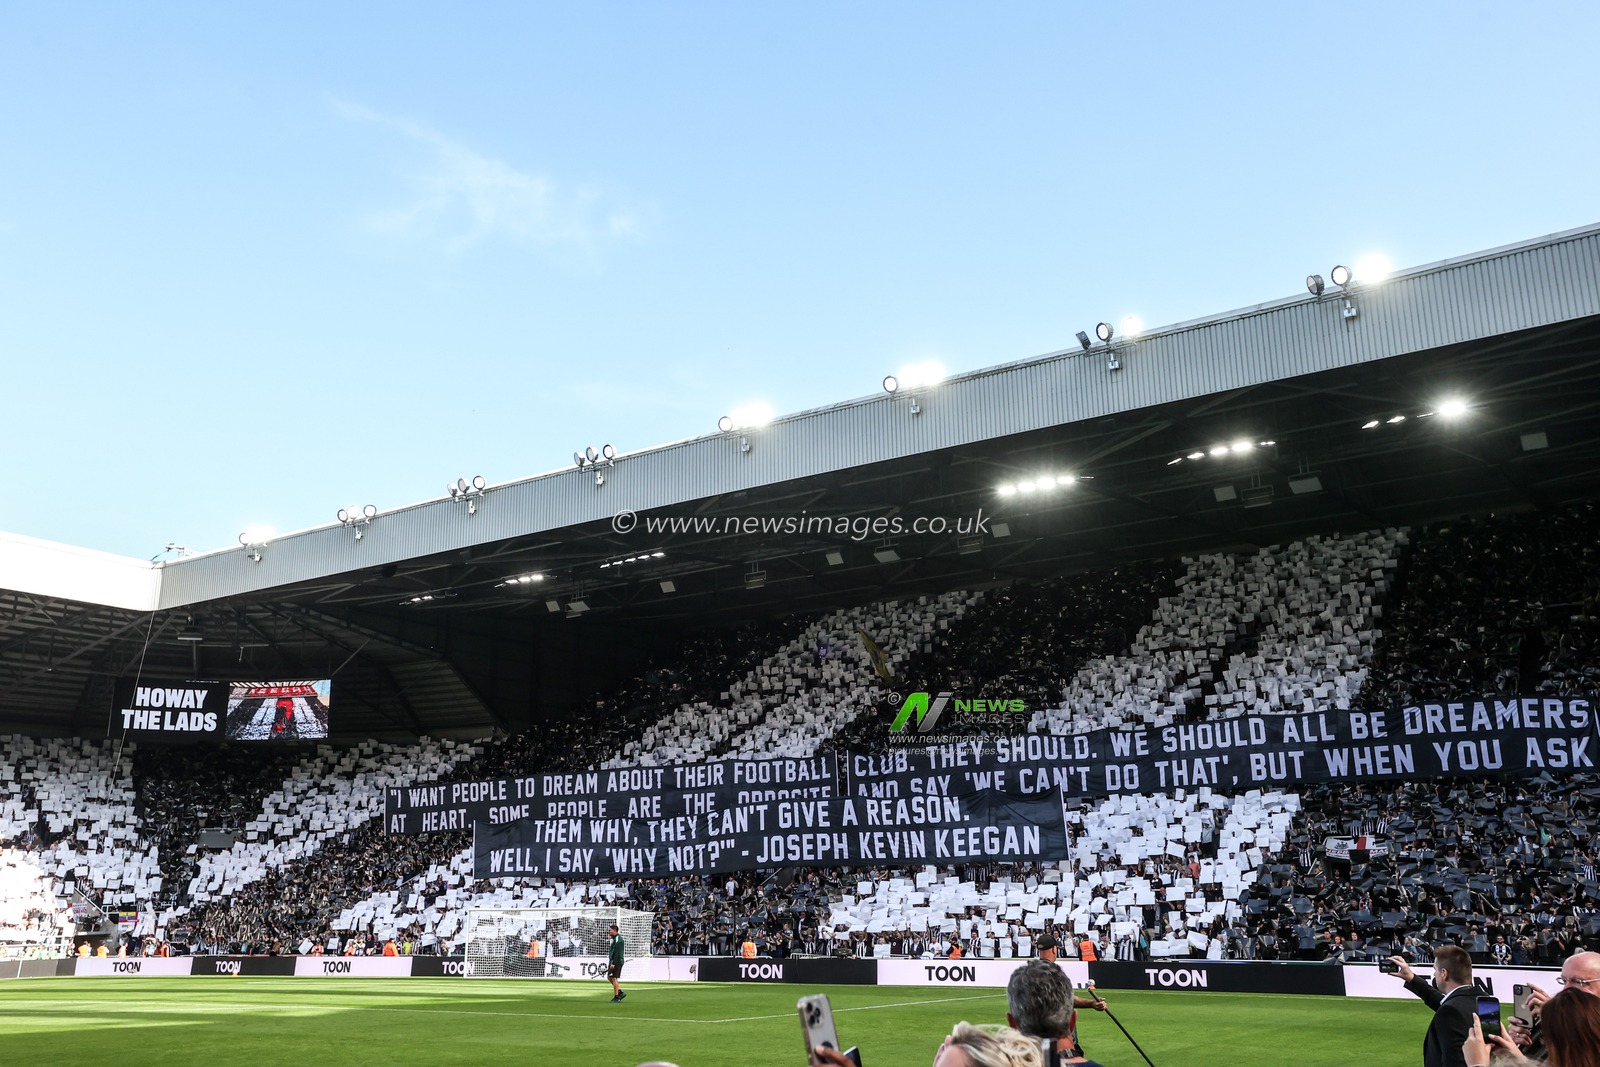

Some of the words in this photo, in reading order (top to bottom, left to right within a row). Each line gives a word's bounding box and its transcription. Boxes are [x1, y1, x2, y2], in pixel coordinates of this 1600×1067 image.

[135, 687, 208, 709] HOWAY
[121, 709, 160, 730] THE
[164, 710, 217, 732] LADS
[854, 752, 915, 777] CLUB.
[925, 740, 983, 770] THEY
[997, 735, 1097, 763] SHOULD.
[1110, 731, 1149, 757] WE
[1162, 717, 1267, 753] SHOULD
[1283, 713, 1335, 744] ALL
[1350, 711, 1388, 740] BE
[1403, 698, 1589, 735] DREAMERS
[910, 774, 951, 796] SAY
[965, 770, 1006, 793] 'WE
[1019, 766, 1090, 794] CAN'T
[1105, 763, 1140, 791] DO
[1154, 755, 1239, 787] THAT',
[1250, 751, 1304, 781] BUT
[1323, 744, 1415, 777] WHEN
[1432, 739, 1503, 771] YOU
[1526, 736, 1594, 768] ASK
[408, 786, 446, 807] WANT
[452, 780, 507, 803] PEOPLE
[514, 777, 535, 799] TO
[543, 772, 598, 796] DREAM
[606, 769, 664, 792] ABOUT
[674, 764, 724, 789] THEIR
[733, 757, 831, 785] FOOTBALL
[390, 814, 407, 833] AT
[422, 808, 472, 832] HEART.
[489, 804, 530, 824] SOME
[548, 799, 607, 818] PEOPLE
[628, 796, 662, 818] ARE
[683, 792, 716, 815] THE
[535, 819, 582, 843] THEM
[590, 818, 639, 846] WHY,
[647, 816, 698, 843] THEY
[708, 805, 768, 837] CAN'T
[778, 801, 832, 829] GIVE
[842, 799, 858, 826] A
[866, 796, 970, 826] REASON.
[490, 848, 538, 875] WELL,
[545, 849, 551, 872] I
[559, 848, 599, 876] SAY,
[606, 848, 657, 873] 'WHY
[757, 832, 849, 863] JOSEPH
[859, 830, 926, 859] KEVIN
[935, 825, 1040, 858] KEEGAN
[113, 961, 141, 973] TOON
[215, 961, 242, 973] TOON
[323, 961, 351, 973] TOON
[580, 963, 608, 977] TOO
[739, 963, 783, 979] TOON
[924, 965, 976, 982] TOON
[1145, 968, 1208, 987] TOON
